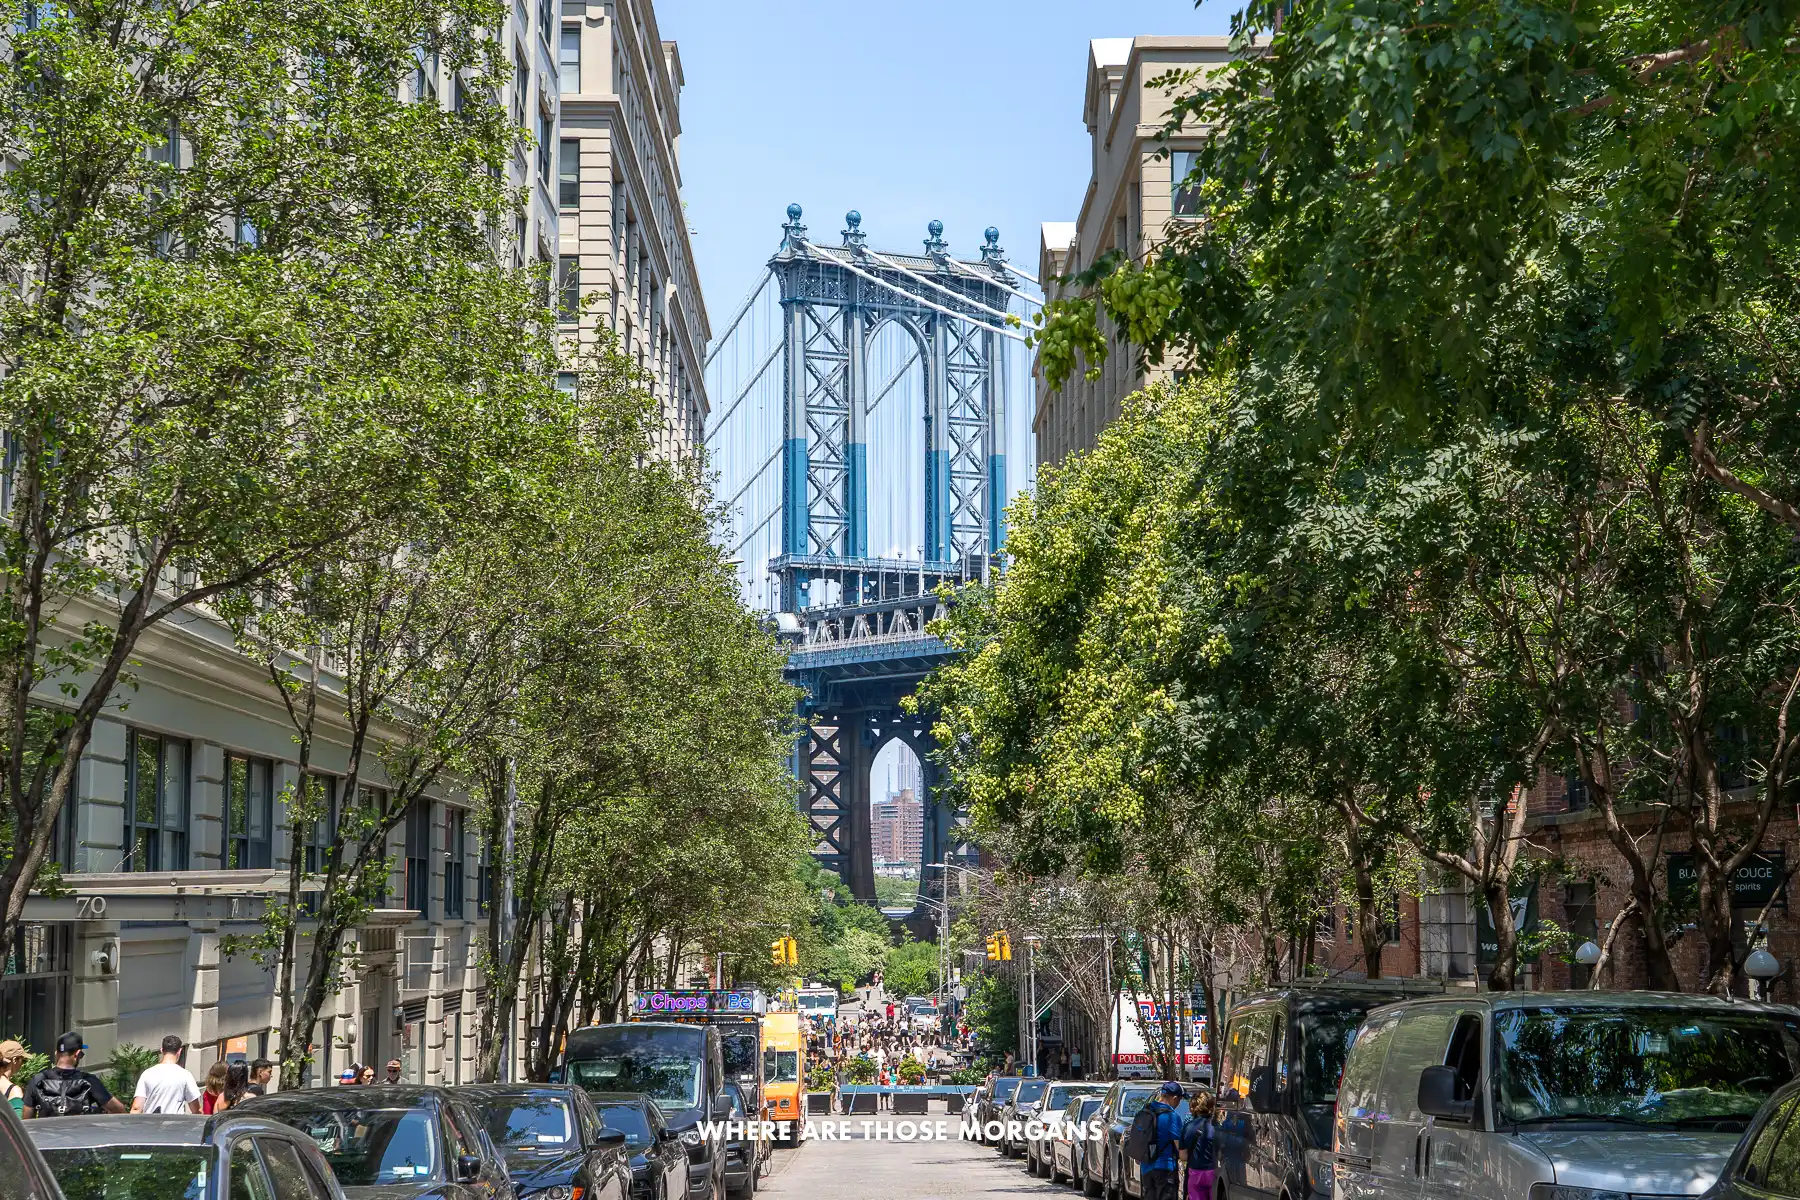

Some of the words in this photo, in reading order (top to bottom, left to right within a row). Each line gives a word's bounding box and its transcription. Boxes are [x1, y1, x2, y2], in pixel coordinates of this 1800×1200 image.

[1736, 867, 1773, 878] OUGE
[1735, 883, 1761, 891] spirits
[75, 896, 107, 918] 70
[650, 993, 707, 1011] Chops
[727, 993, 750, 1009] Be
[1187, 1054, 1206, 1064] BEEF
